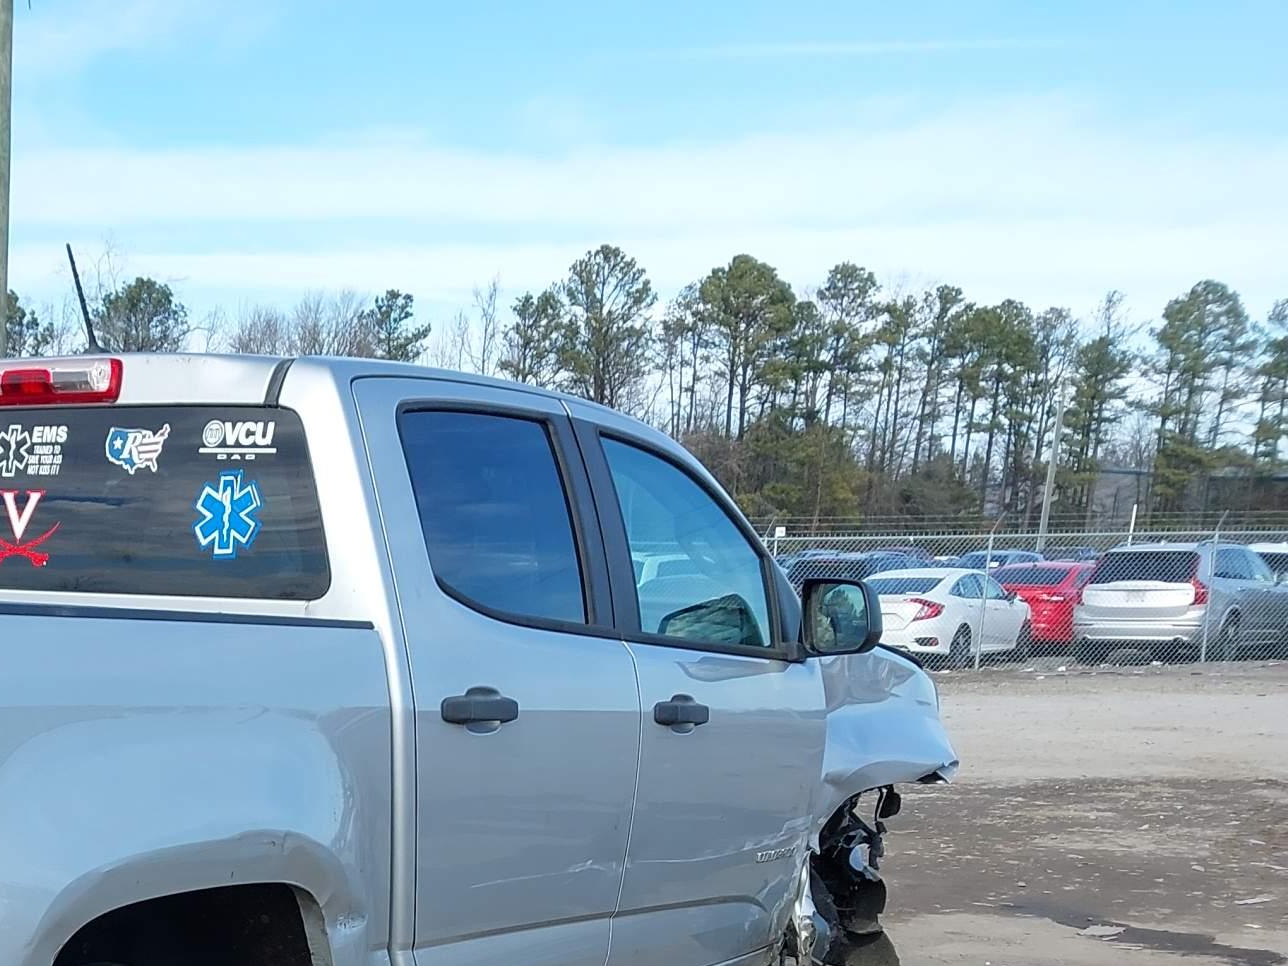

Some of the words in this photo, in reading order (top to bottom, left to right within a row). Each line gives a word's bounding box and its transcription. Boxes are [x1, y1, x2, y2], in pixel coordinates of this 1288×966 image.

[32, 425, 68, 443] EMS
[224, 421, 275, 446] VCU
[27, 465, 39, 475] NOT
